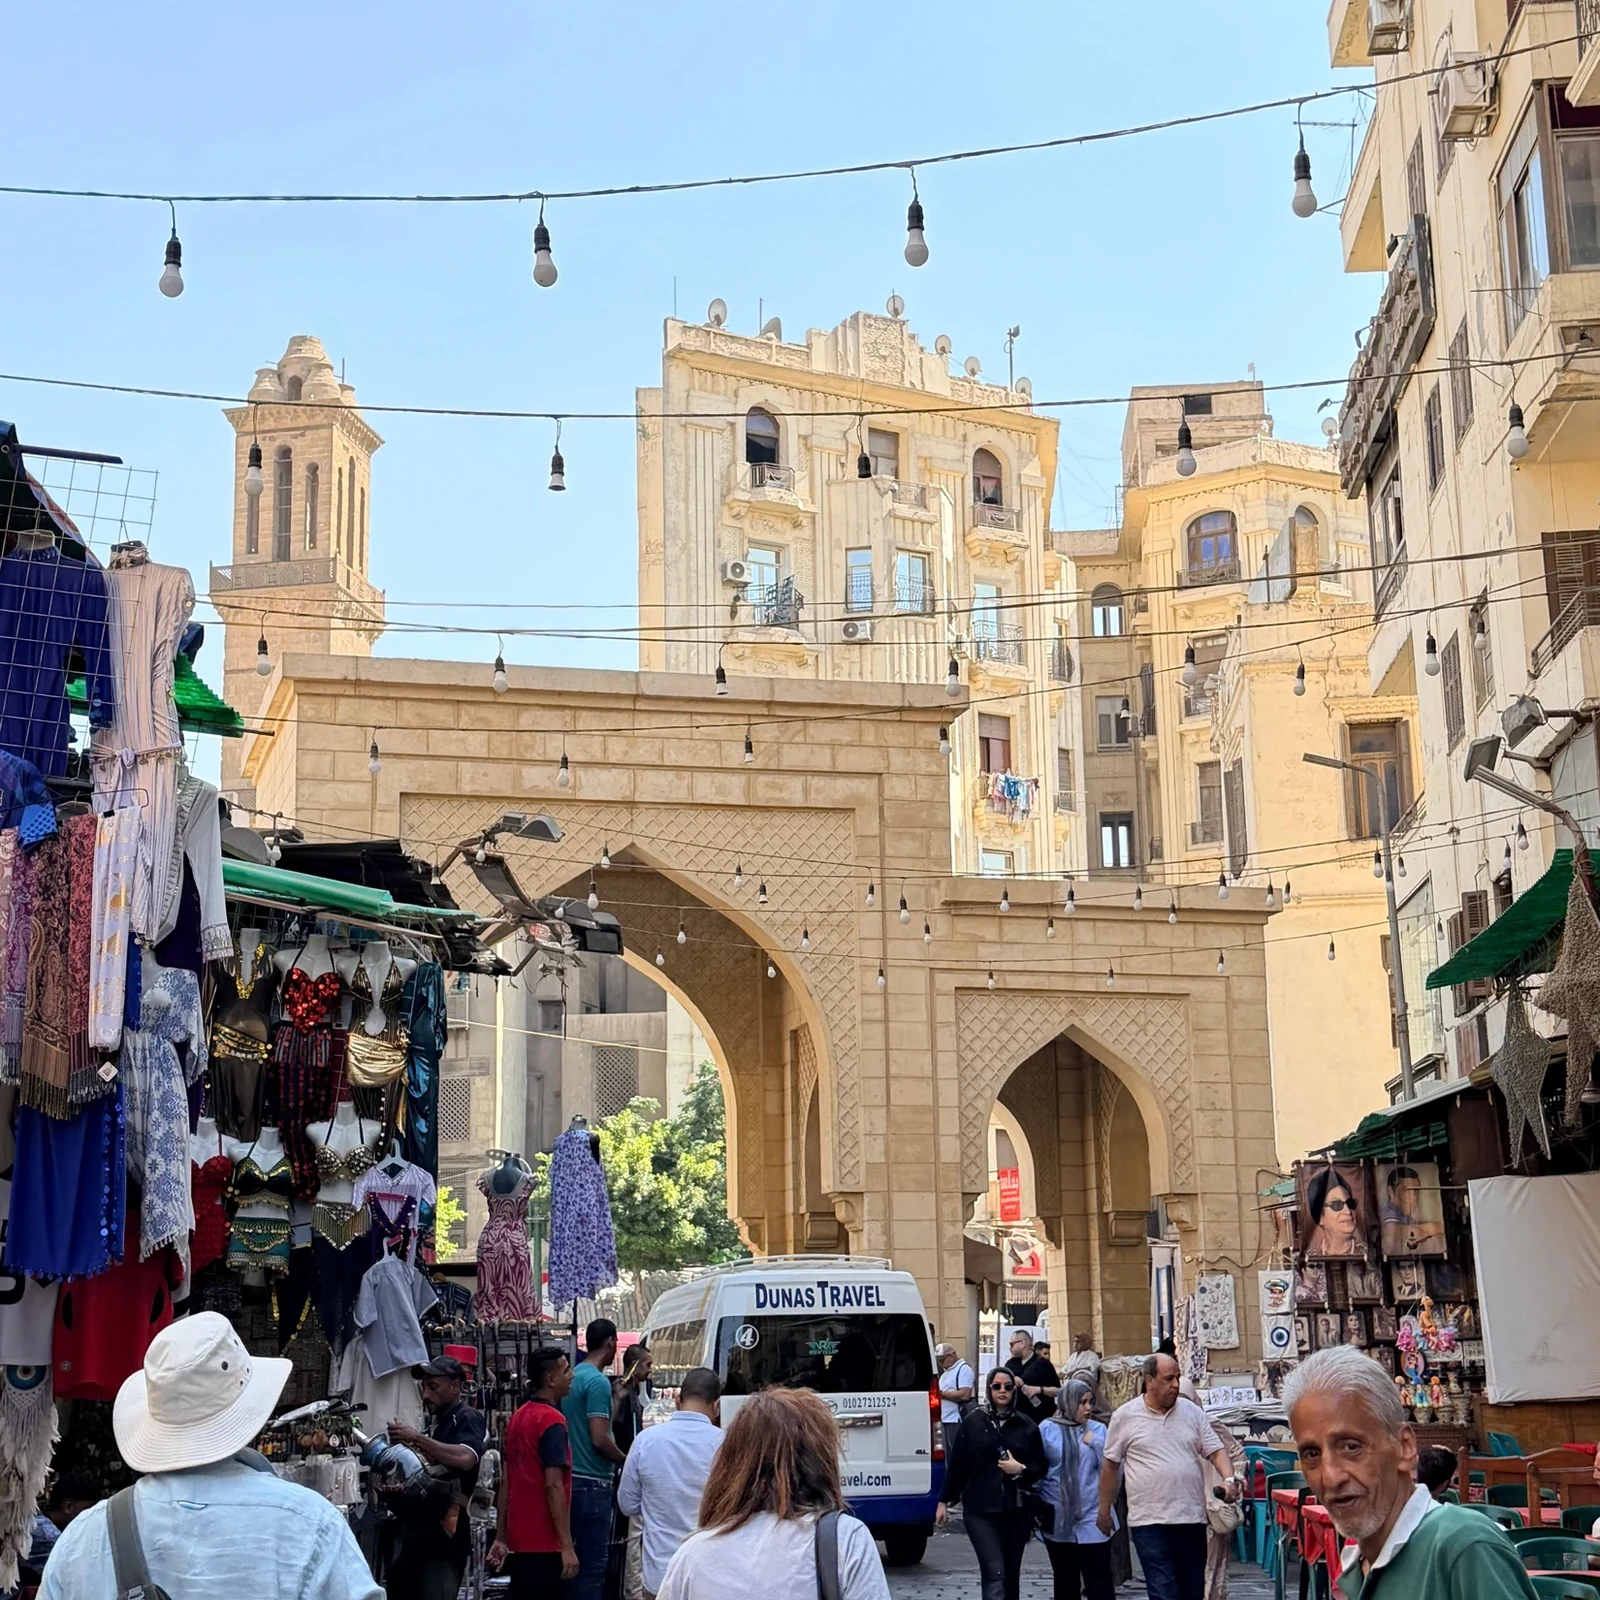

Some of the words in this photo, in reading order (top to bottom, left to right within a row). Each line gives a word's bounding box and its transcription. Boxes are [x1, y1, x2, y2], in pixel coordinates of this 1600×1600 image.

[755, 1283, 816, 1309] DUNAS
[816, 1280, 886, 1307] TRAVEL
[740, 1327, 754, 1347] 4
[842, 1397, 897, 1409] 01027212524
[840, 1471, 892, 1487] avel.com
